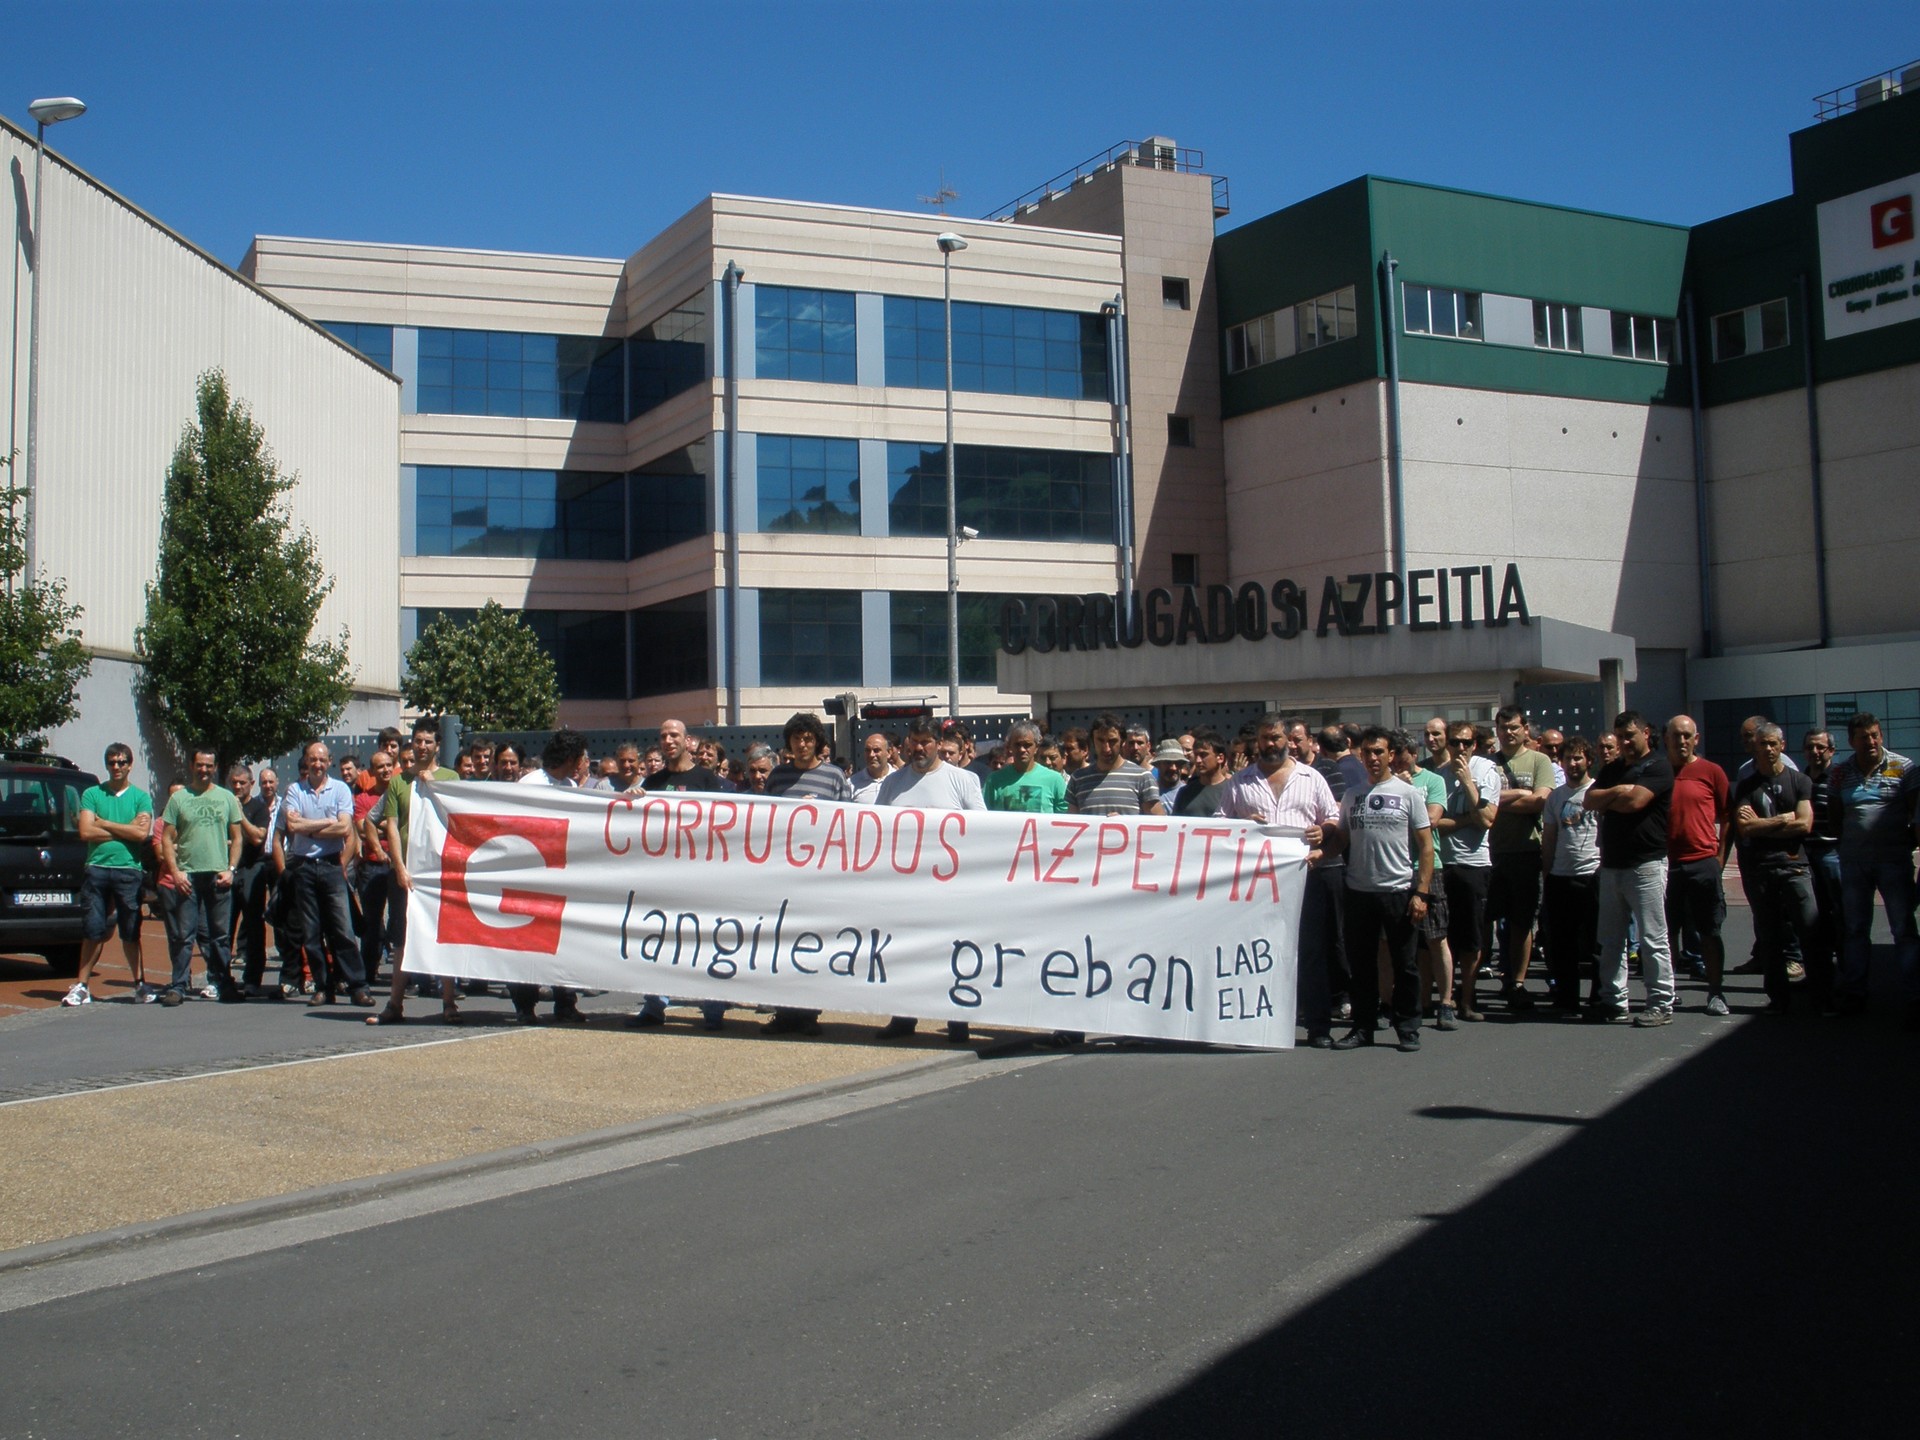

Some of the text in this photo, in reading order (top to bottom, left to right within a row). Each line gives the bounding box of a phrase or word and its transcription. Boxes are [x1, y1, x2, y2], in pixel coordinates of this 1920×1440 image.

[1828, 264, 1905, 299] CORRUGADOS
[1001, 562, 1531, 655] CORRUGADOS AZPEITIA
[604, 797, 967, 882] CORRUGADOS
[436, 812, 570, 955] G
[620, 889, 1194, 1012] langileak greban
[1216, 938, 1273, 979] LAB
[1218, 985, 1273, 1020] ELA
